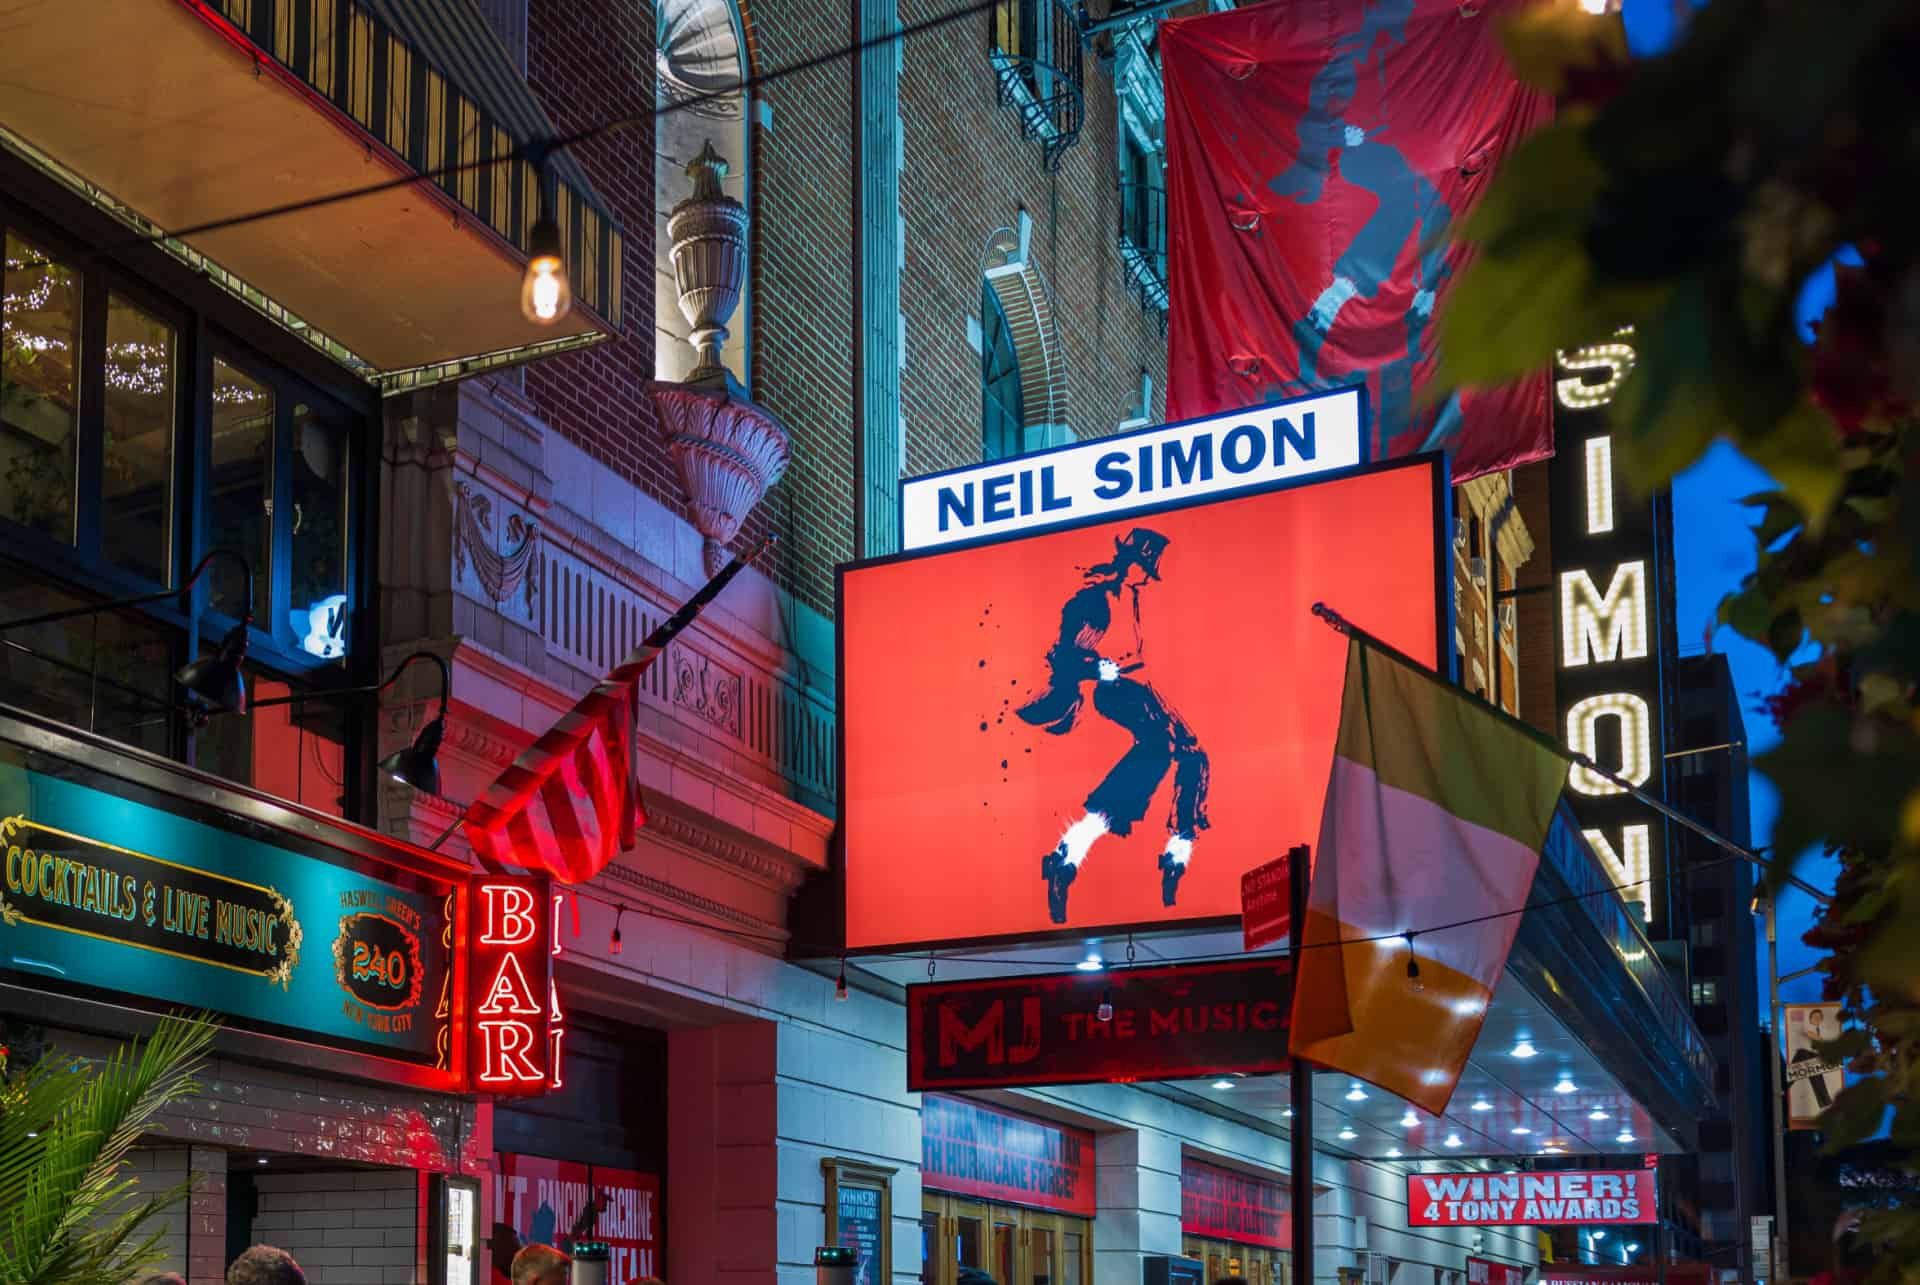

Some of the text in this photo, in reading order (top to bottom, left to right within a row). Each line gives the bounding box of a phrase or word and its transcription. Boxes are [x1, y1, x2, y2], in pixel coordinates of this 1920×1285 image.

[938, 411, 1316, 532] NEIL SIMON
[1556, 325, 1652, 922] SIMON
[6, 846, 279, 955] COCKTAILS & LIVE MUSIC
[352, 940, 406, 989] 240
[478, 885, 545, 1081] BAR
[343, 1000, 362, 1024] NEW
[392, 1013, 413, 1033] CITY
[937, 997, 1290, 1068] MJ THE MUSIC
[946, 1142, 1028, 1190] HURRICANE
[1423, 1174, 1637, 1201] WINNER!
[599, 1186, 652, 1240] MACHINE
[1423, 1198, 1640, 1221] 4 TONY AWARDS
